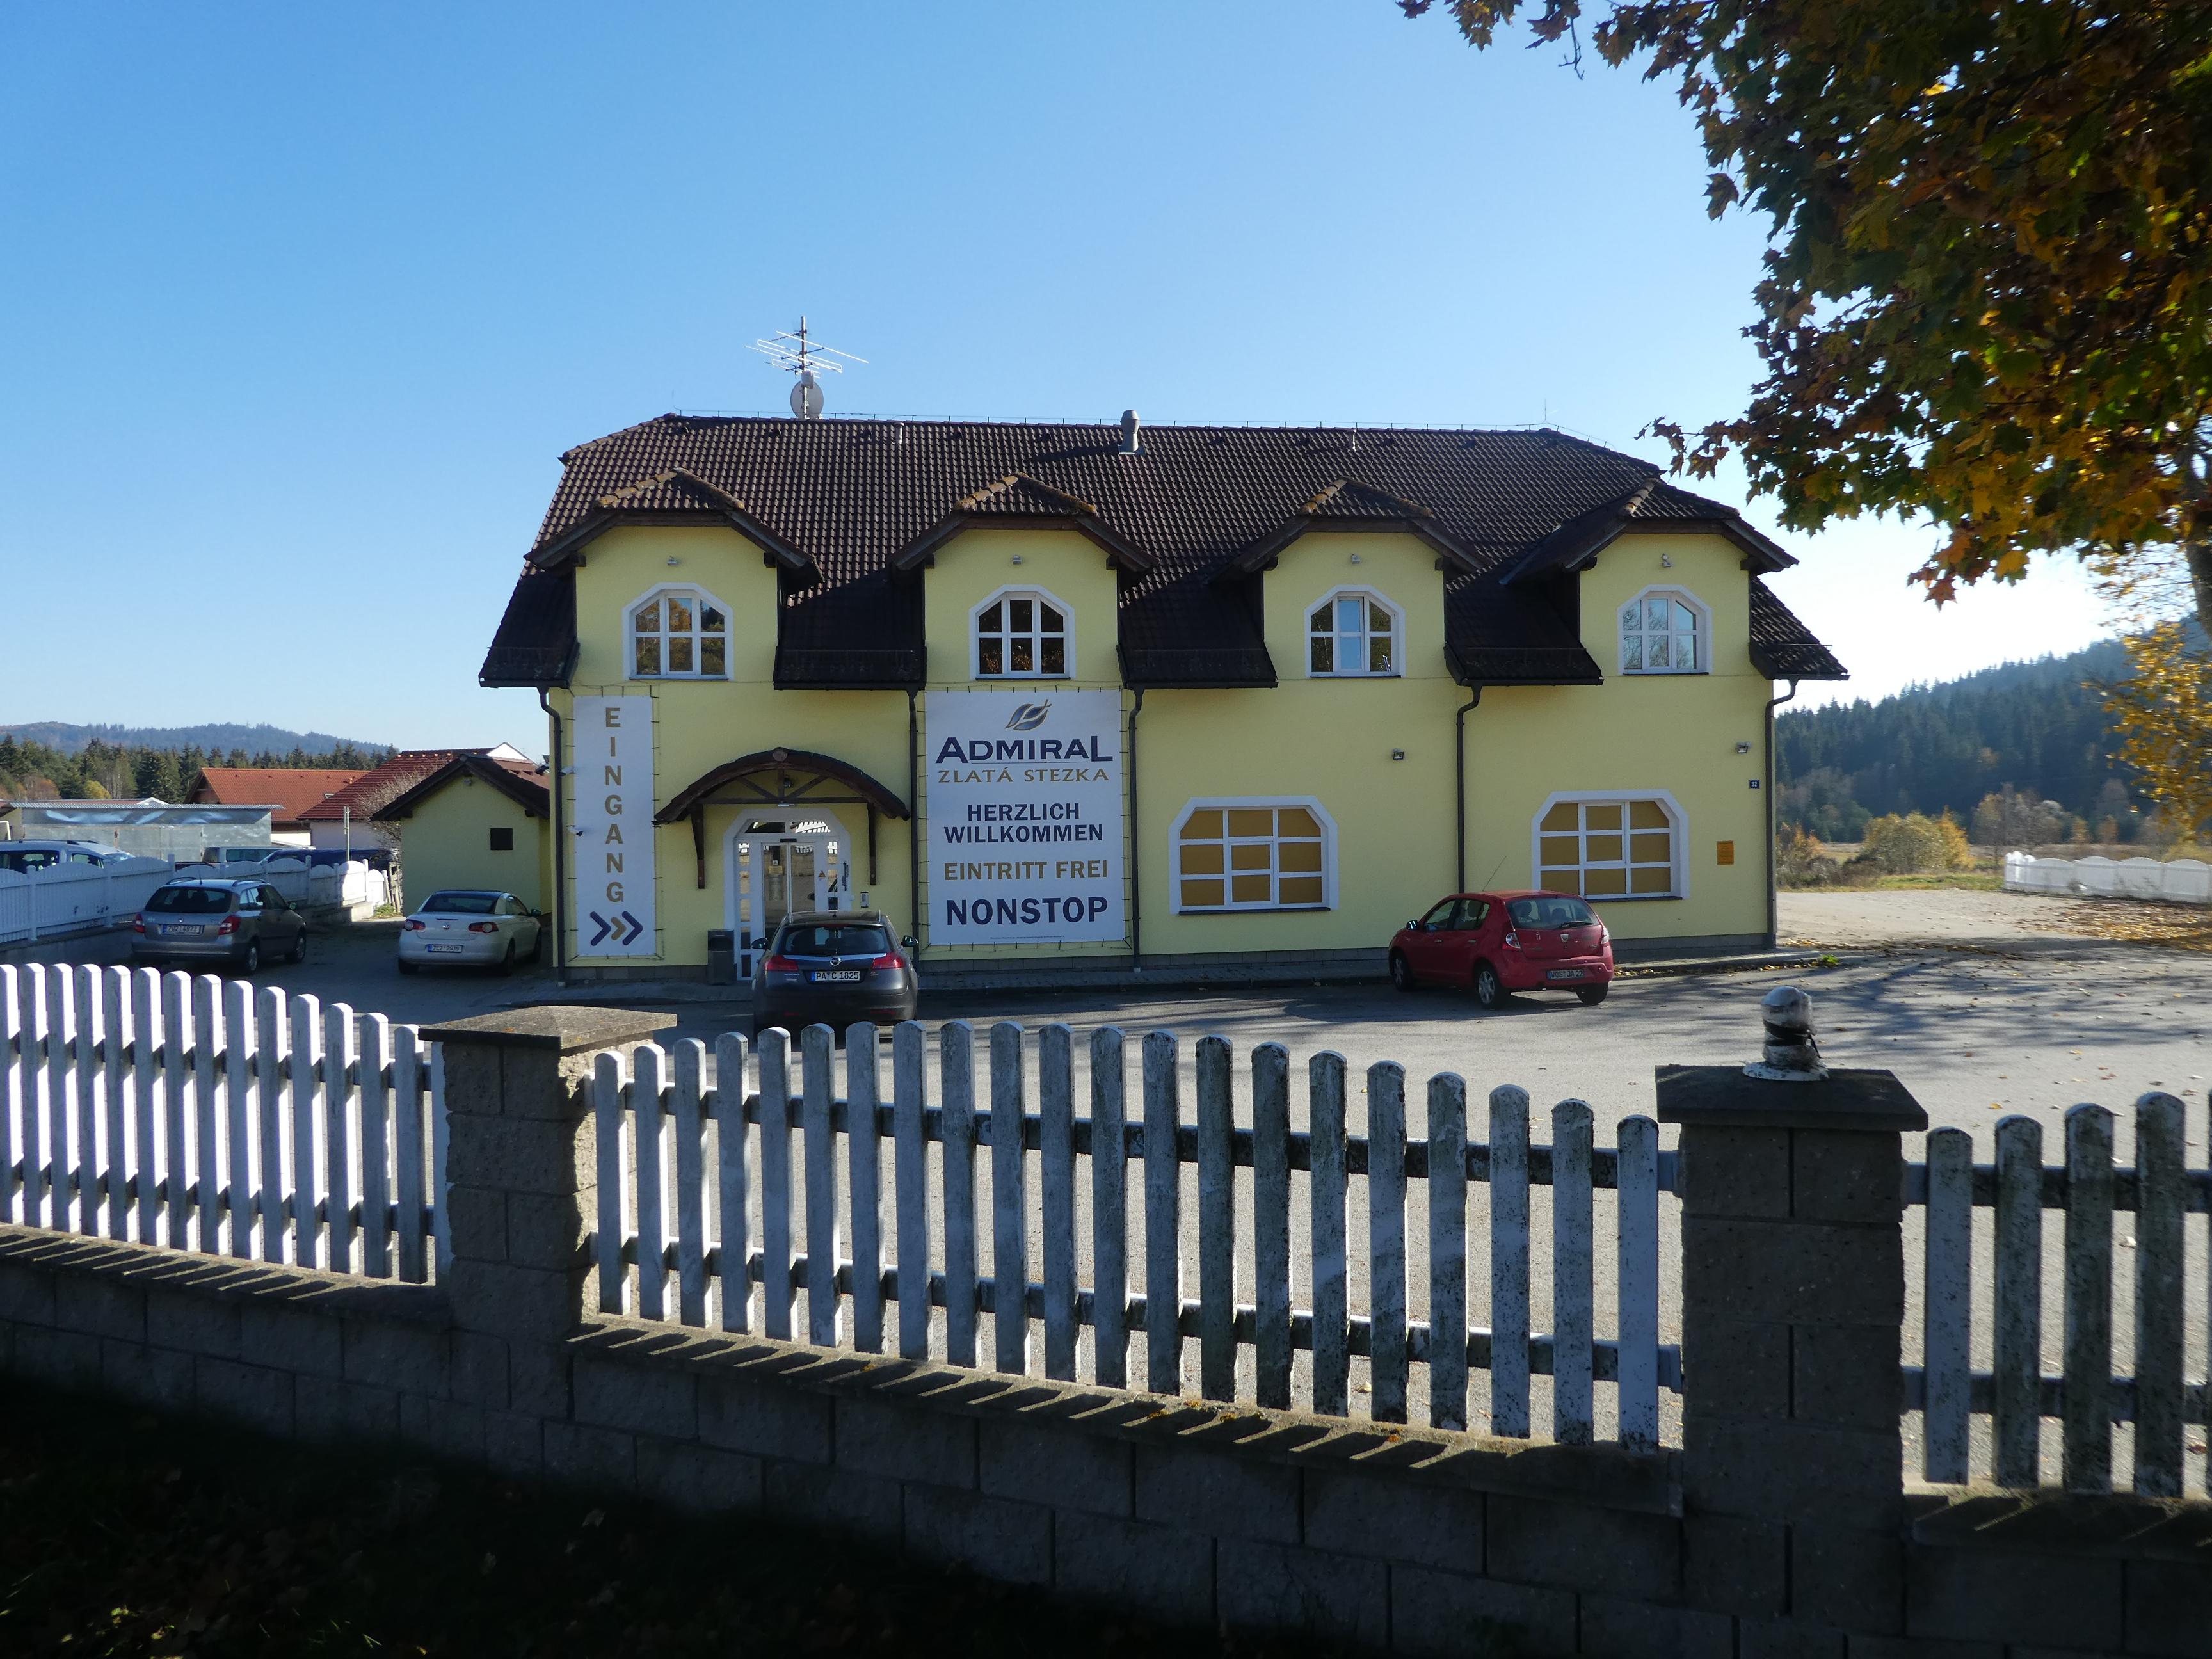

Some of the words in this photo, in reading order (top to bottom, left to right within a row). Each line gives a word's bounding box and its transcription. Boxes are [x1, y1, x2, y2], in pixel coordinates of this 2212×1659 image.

[935, 735, 1113, 764] ADMIRAL
[938, 767, 1013, 783] ZLATÁ
[1024, 767, 1109, 782] STEZKA
[605, 707, 624, 902] EINGANG
[968, 803, 1080, 821] HERZLICH
[944, 824, 1103, 844] WILLKOMMEN
[944, 862, 1047, 881] EINTRITT
[1056, 860, 1107, 879] FREI
[947, 896, 1108, 926] NONSTOP
[831, 972, 837, 980] C
